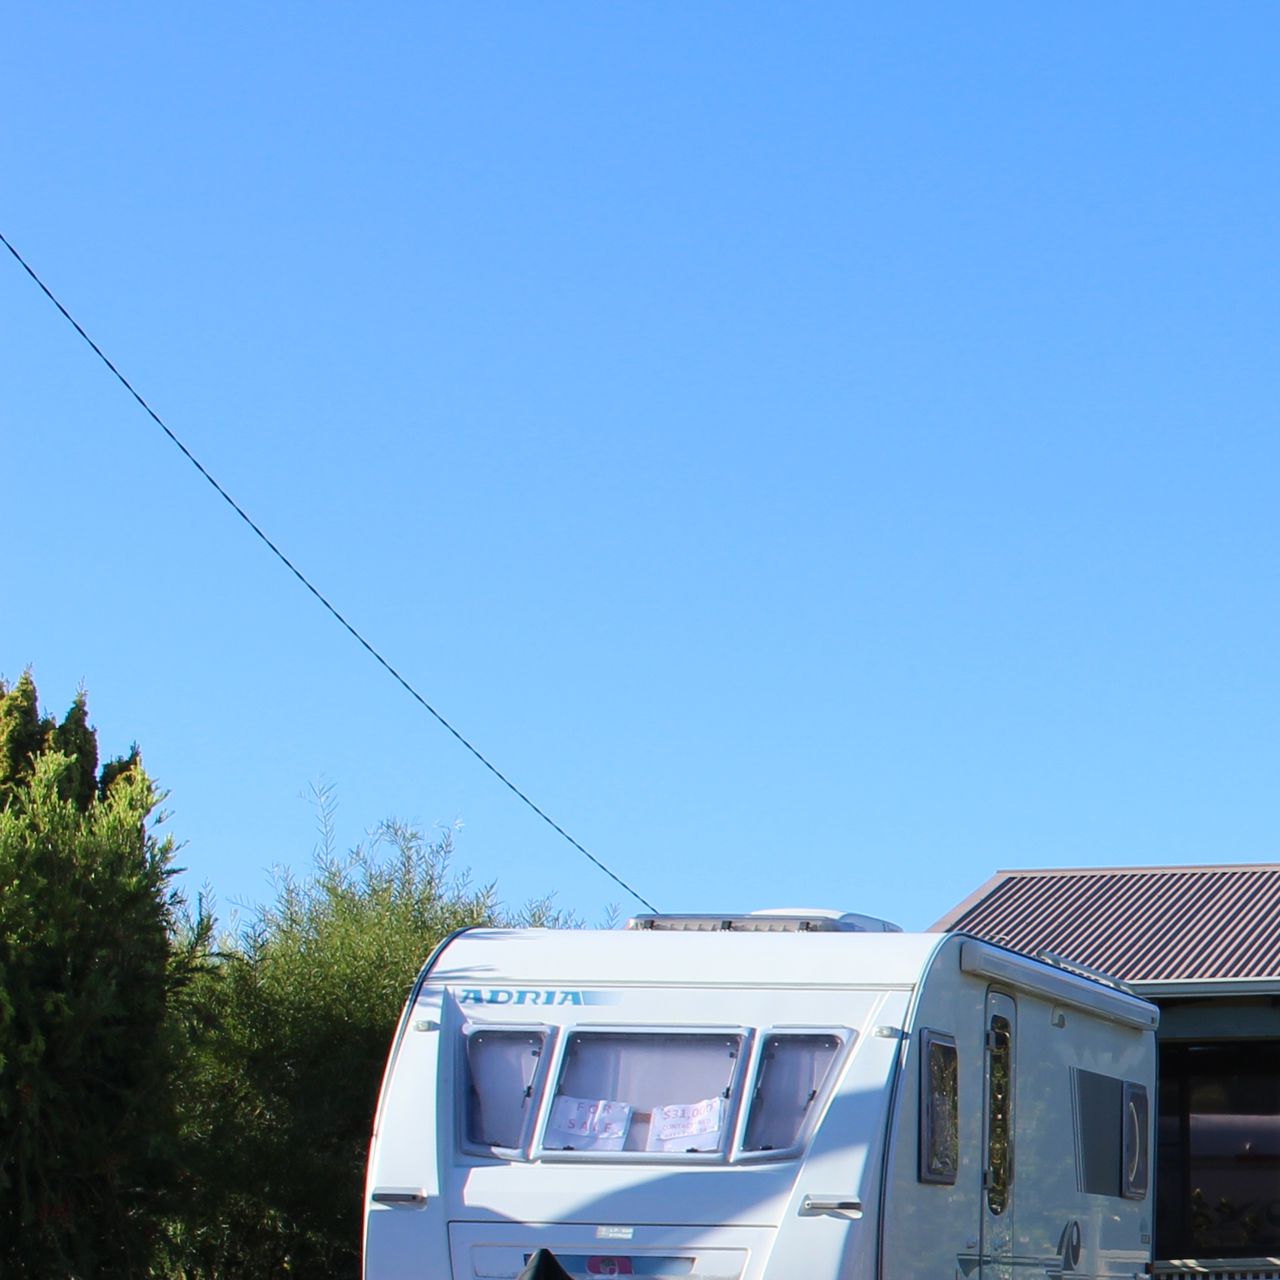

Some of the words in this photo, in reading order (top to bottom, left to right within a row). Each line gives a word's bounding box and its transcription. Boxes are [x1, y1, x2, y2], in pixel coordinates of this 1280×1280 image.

[460, 989, 583, 1006] ADRIA
[576, 1102, 612, 1115] FOR
[568, 1119, 612, 1133] SALE
